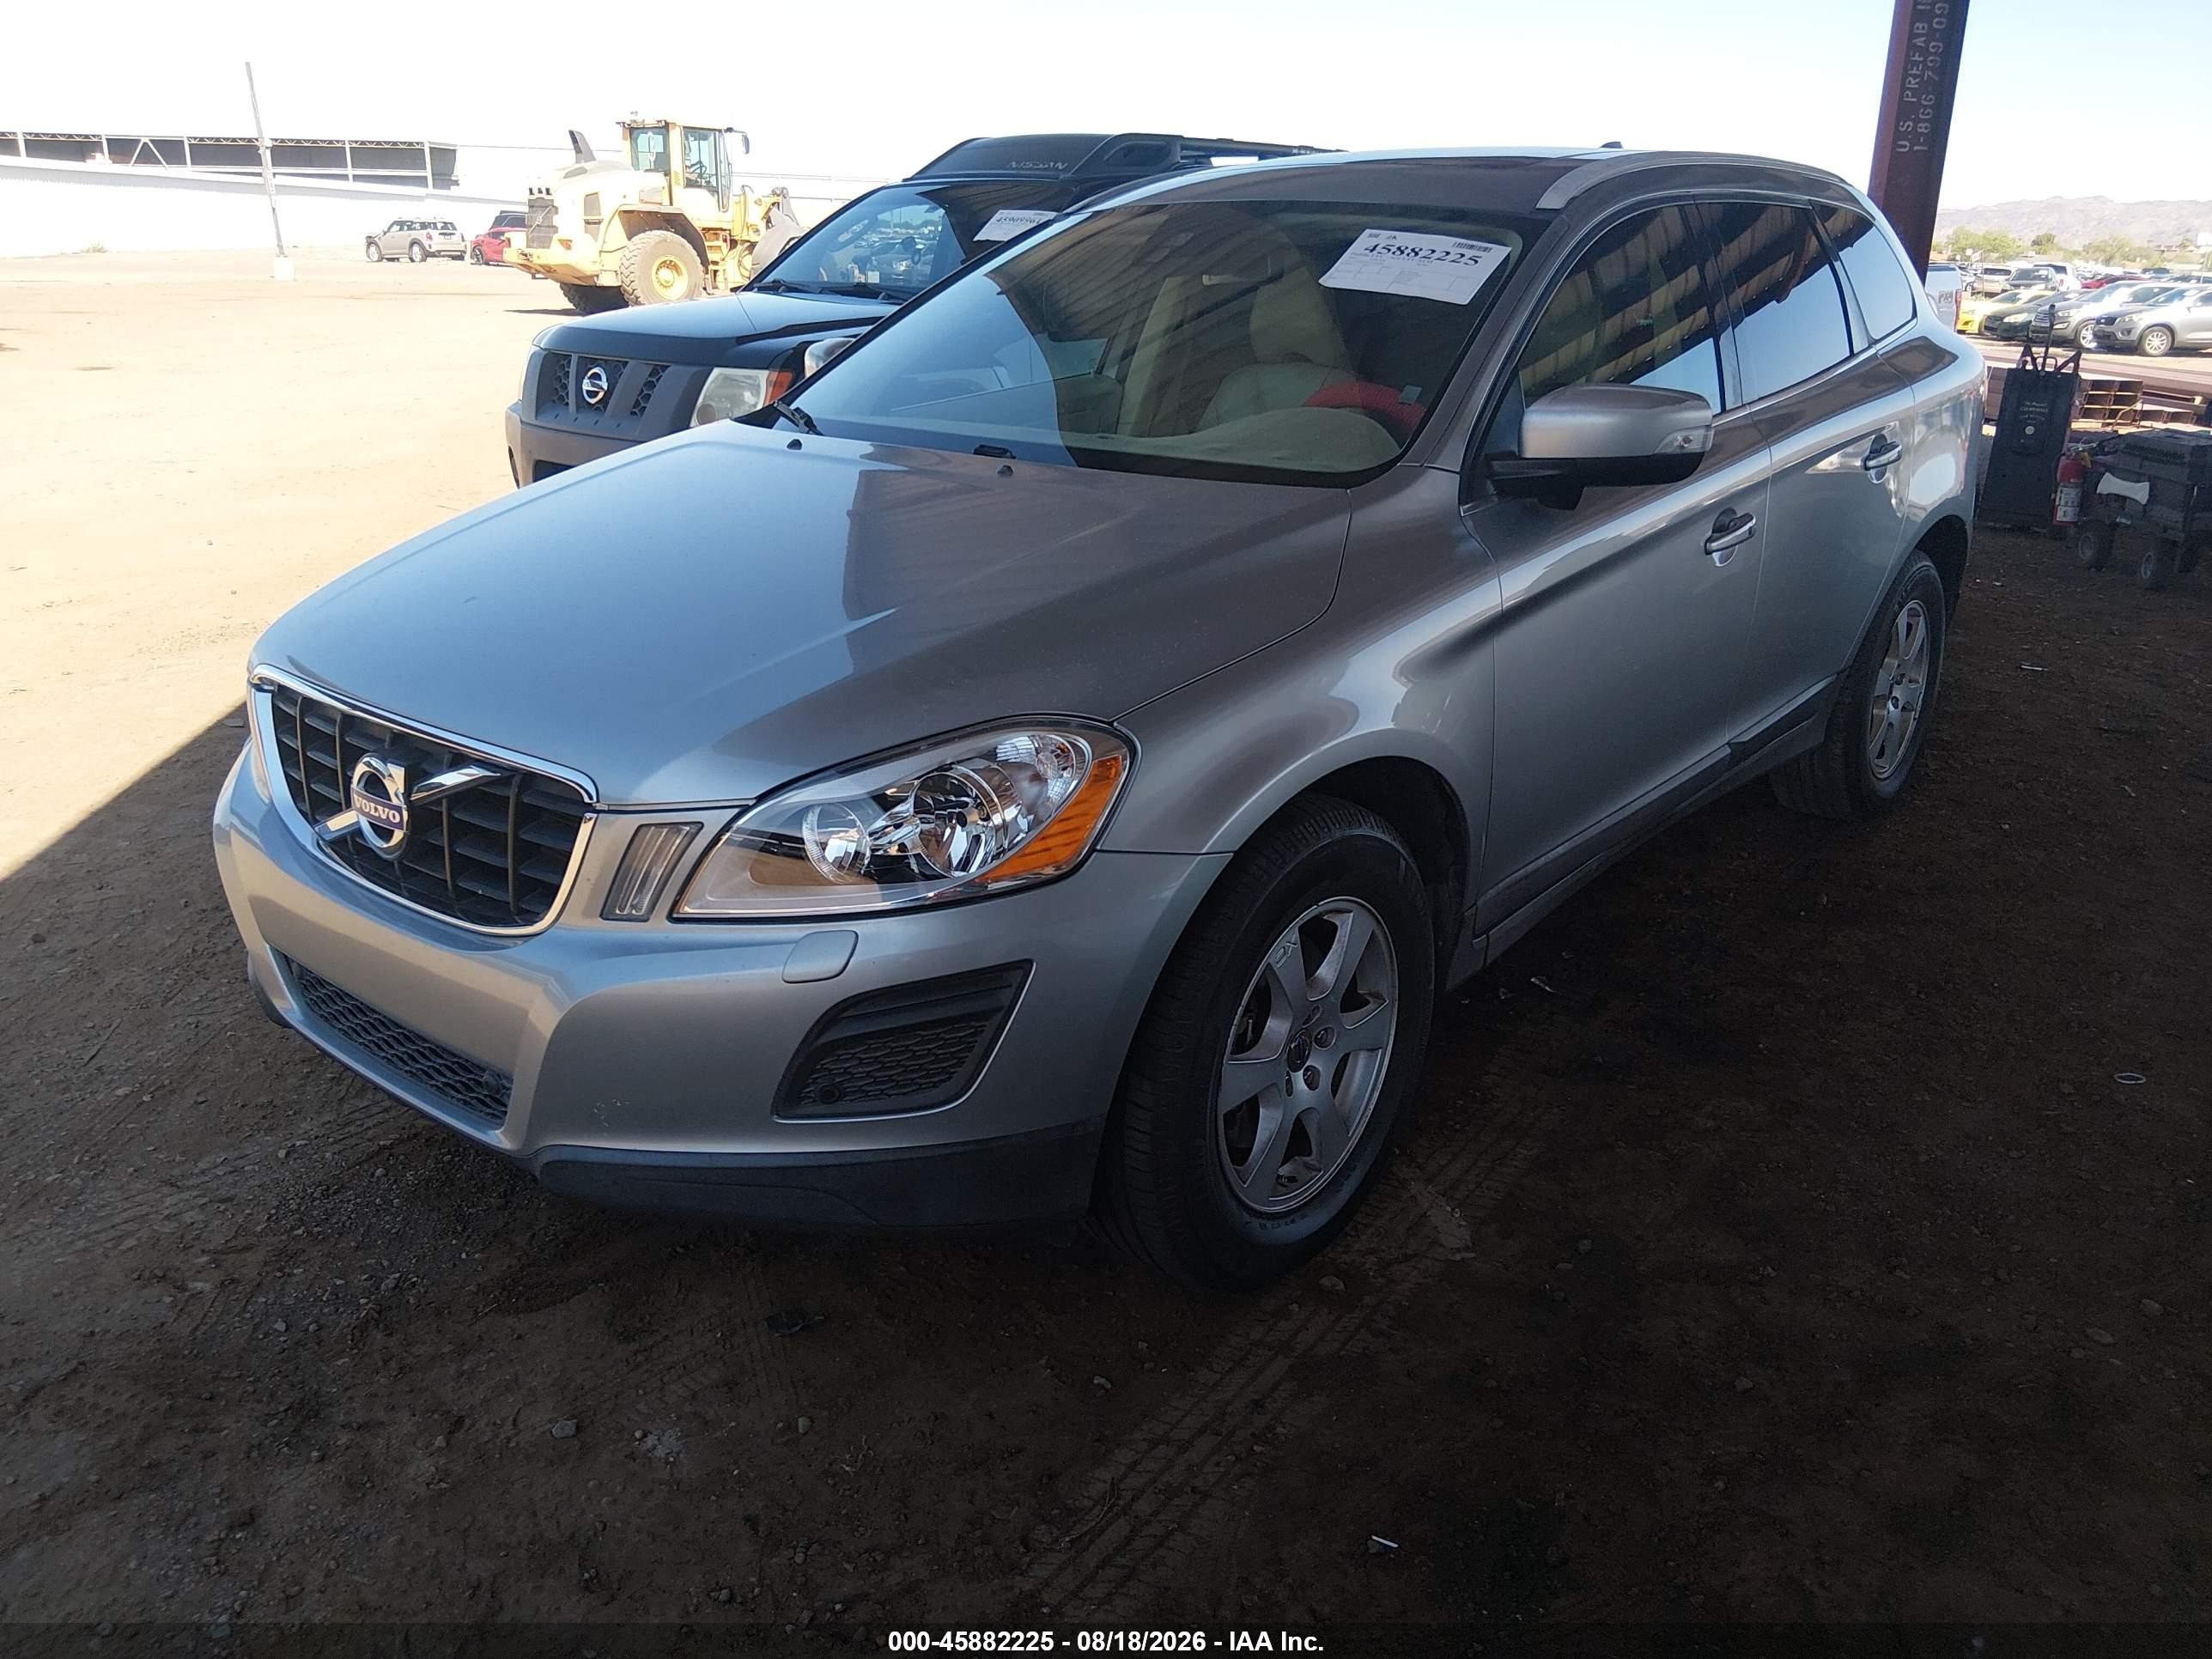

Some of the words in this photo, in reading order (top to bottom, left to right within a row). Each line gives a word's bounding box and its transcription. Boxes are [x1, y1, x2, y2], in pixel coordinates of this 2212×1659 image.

[1903, 22, 1928, 102] PREFAB
[1896, 115, 1916, 152] U.S.
[1364, 243, 1483, 266] 45882225
[353, 793, 401, 823] VOLVO
